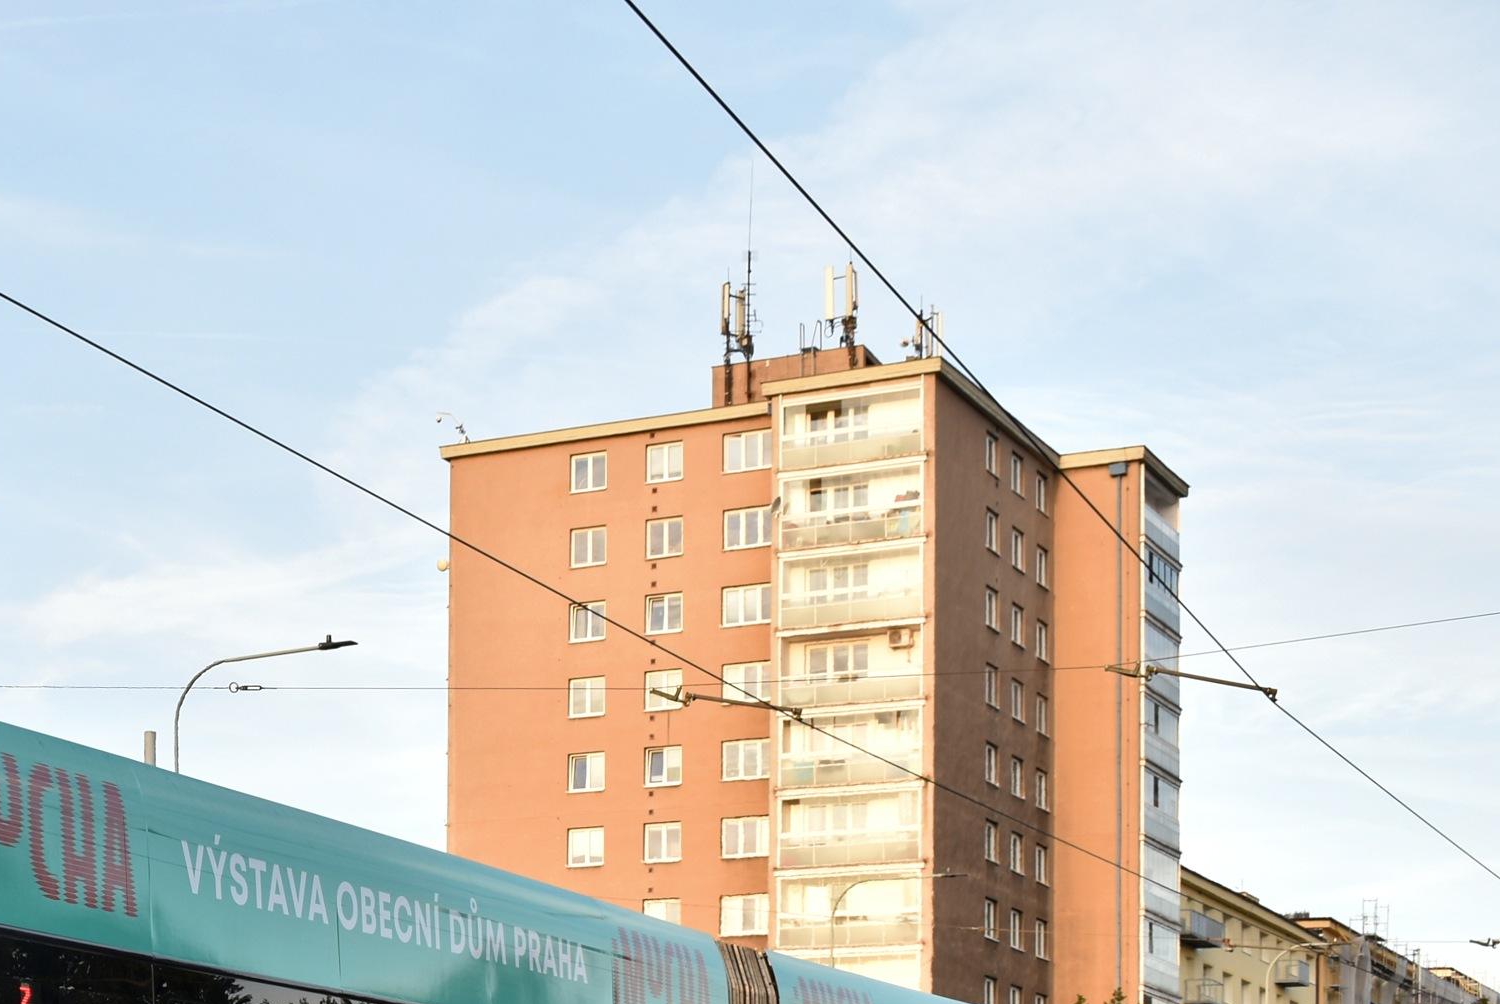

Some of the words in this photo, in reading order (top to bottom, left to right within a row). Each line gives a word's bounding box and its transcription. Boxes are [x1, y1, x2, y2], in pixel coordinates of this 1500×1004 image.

[180, 834, 329, 925] VÝSTAVA
[336, 880, 441, 951] OBECNÍ
[449, 898, 508, 966] DŮM
[514, 926, 589, 985] PRAHA
